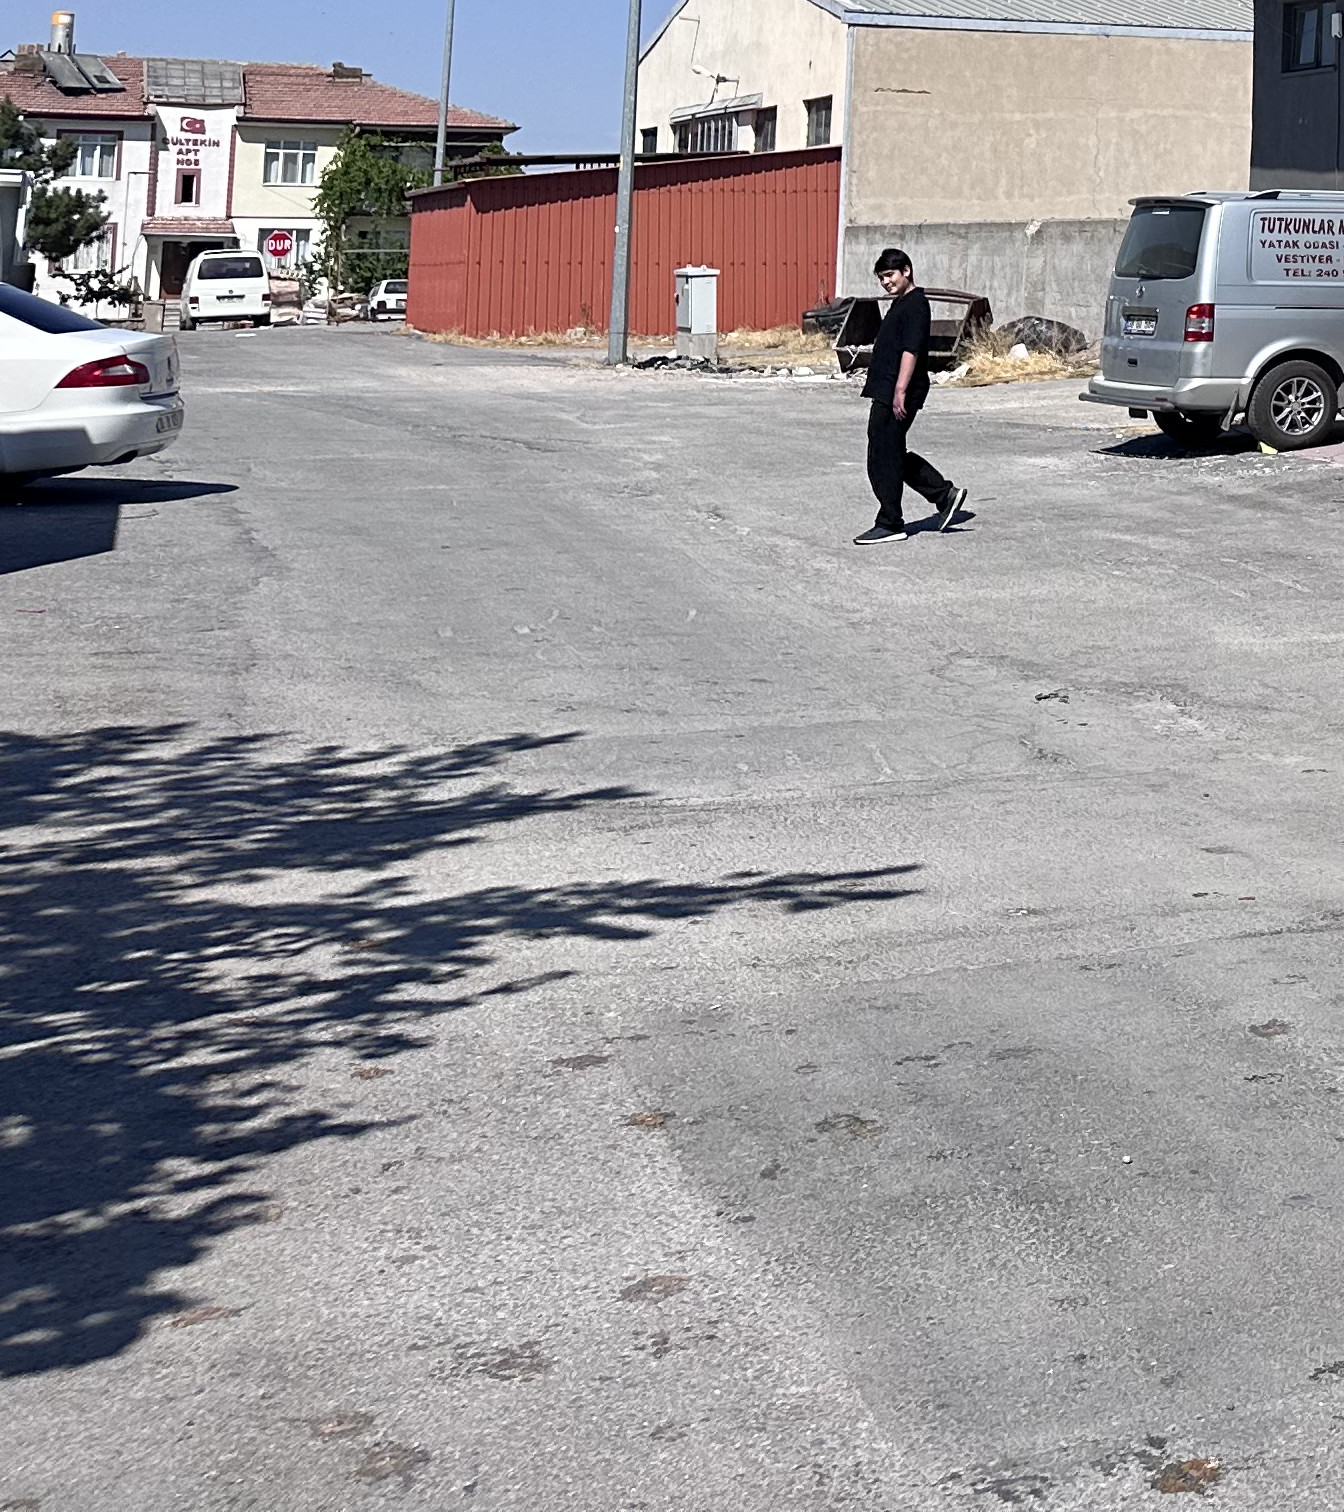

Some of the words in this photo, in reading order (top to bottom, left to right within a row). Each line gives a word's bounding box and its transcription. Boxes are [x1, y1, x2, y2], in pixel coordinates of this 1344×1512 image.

[176, 147, 200, 156] APT
[1259, 216, 1335, 236] TUTKUNLAR
[268, 239, 292, 251] DUR
[1259, 239, 1300, 249] YATAK
[1303, 240, 1340, 250] ODASI
[1275, 253, 1333, 265] VESTİYER
[1315, 268, 1339, 278] 240
